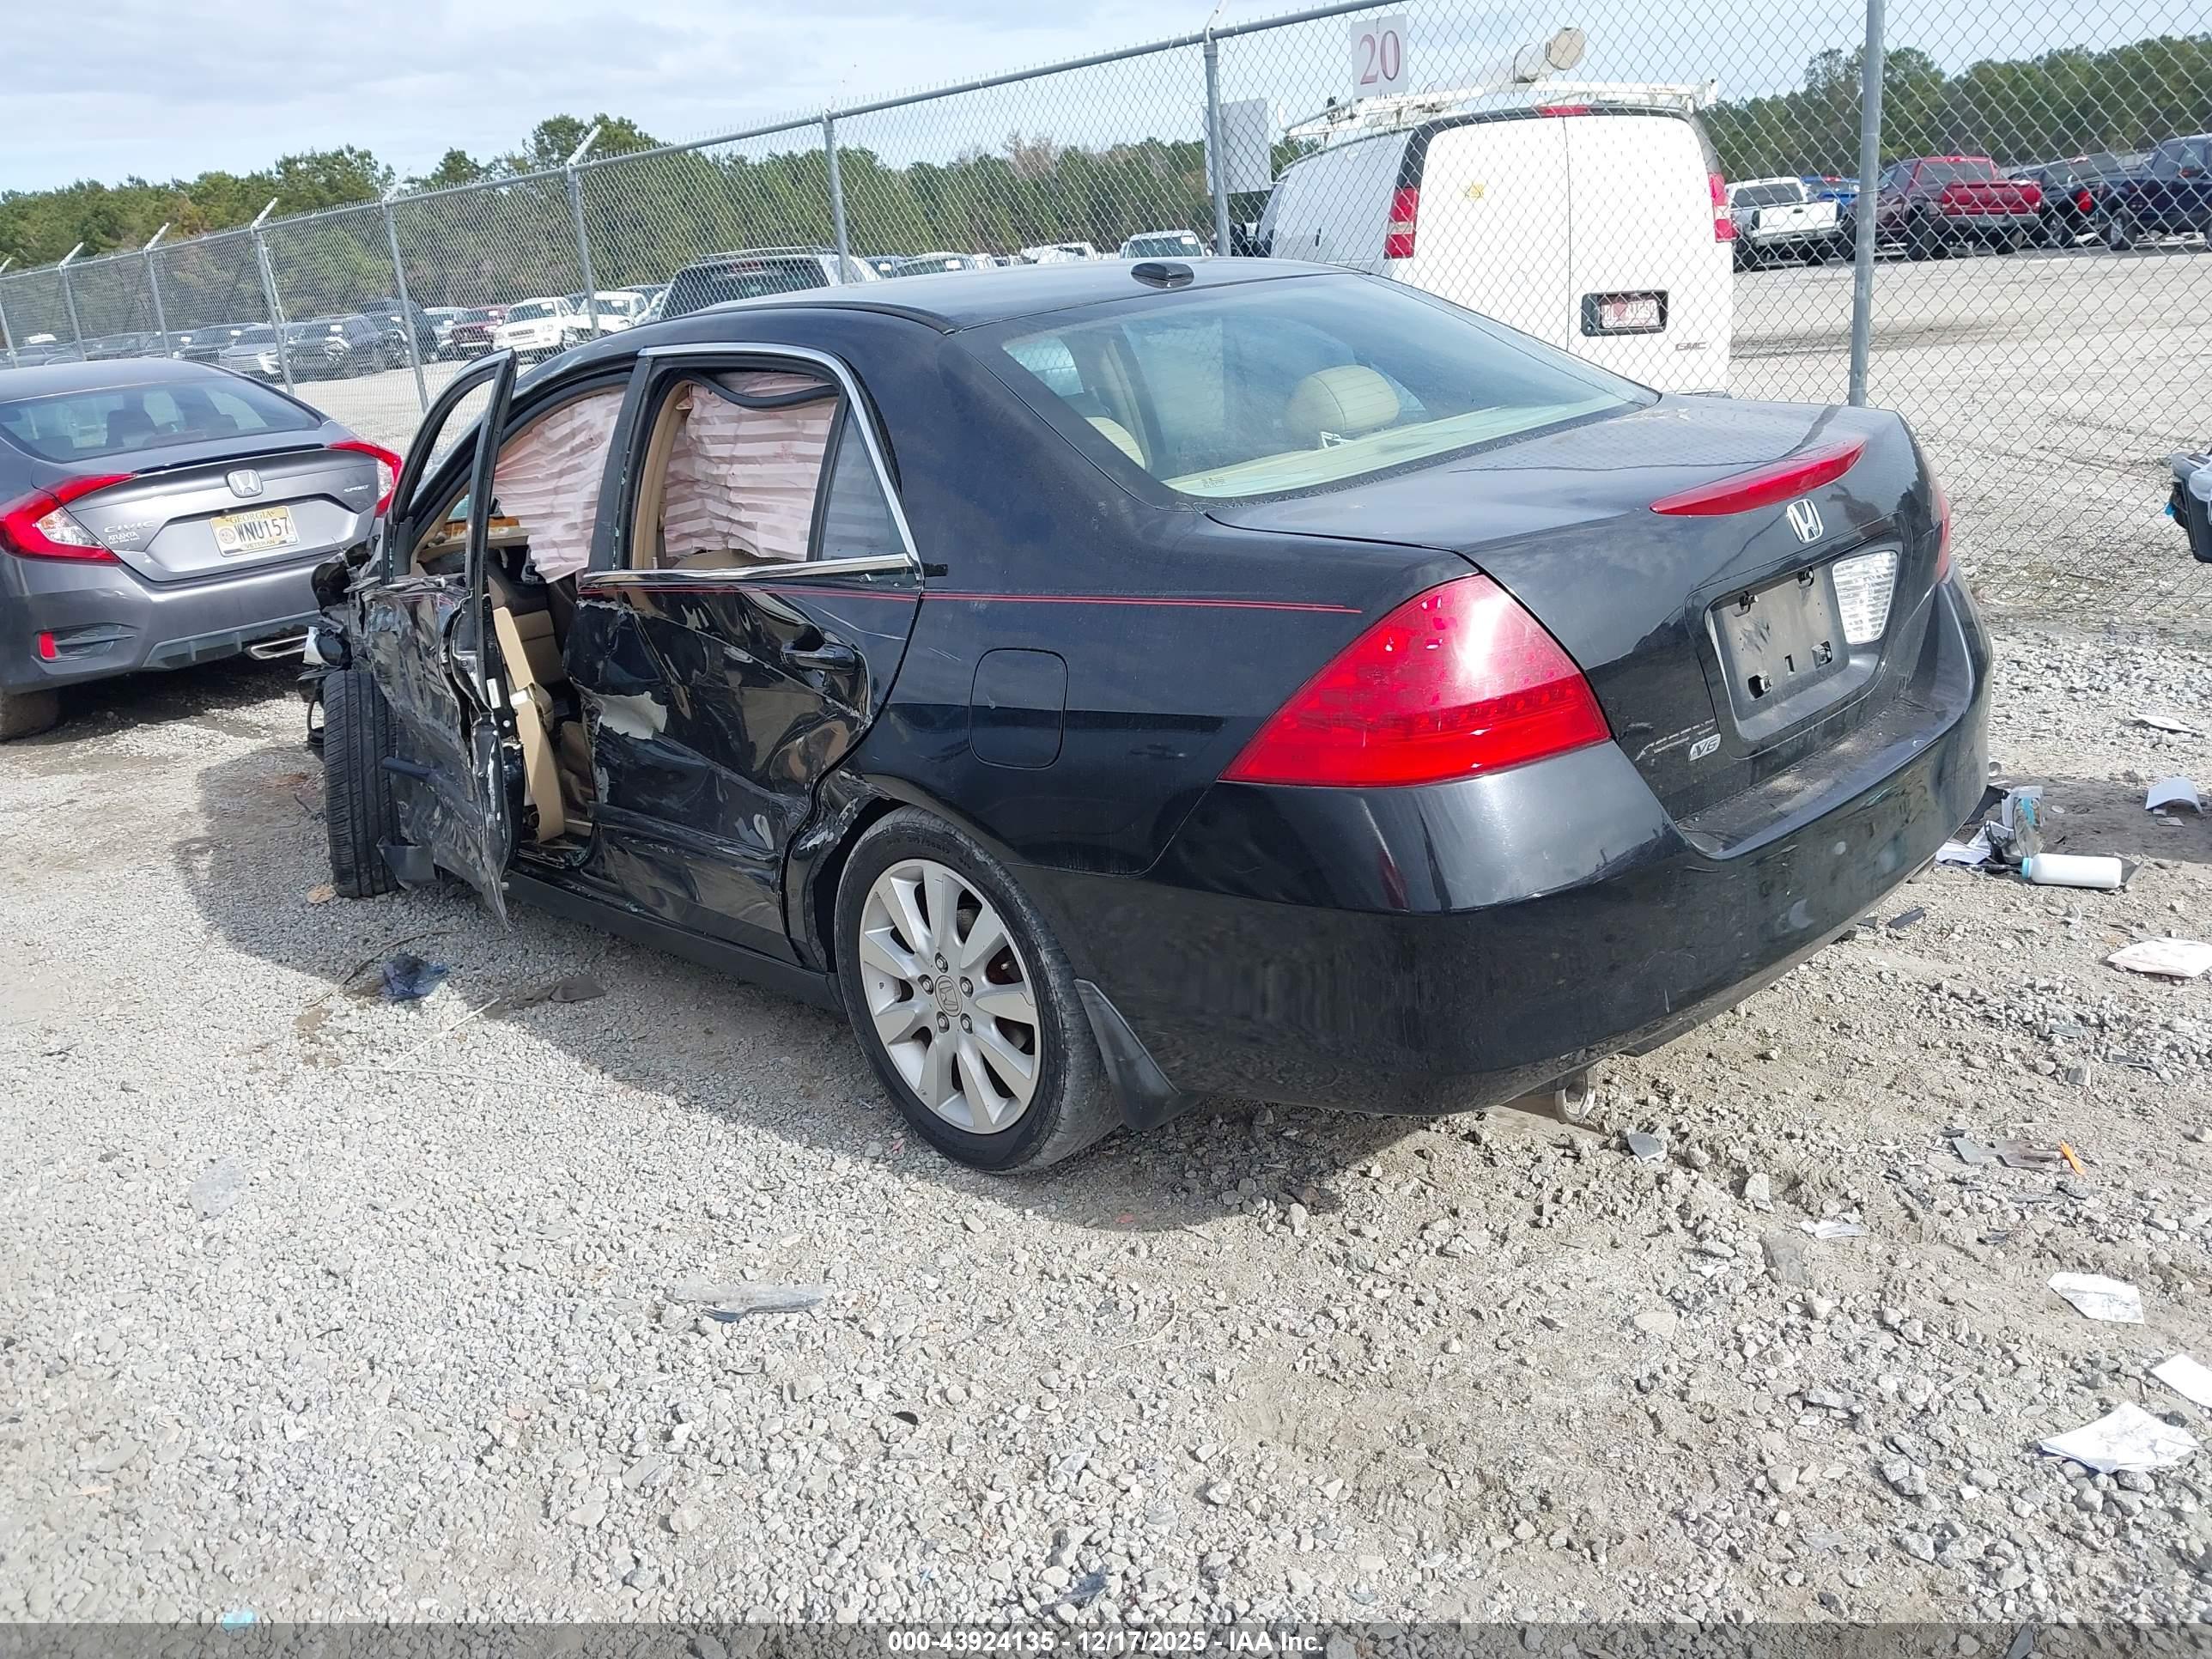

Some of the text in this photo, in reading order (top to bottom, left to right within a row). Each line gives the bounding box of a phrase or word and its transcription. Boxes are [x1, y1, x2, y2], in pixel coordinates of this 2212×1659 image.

[1358, 30, 1401, 85] 20
[1675, 342, 1707, 351] GMC
[104, 520, 155, 533] CIVIC
[229, 510, 273, 524] GEORGIA
[234, 517, 289, 543] WNU157
[1692, 735, 1720, 759] V6
